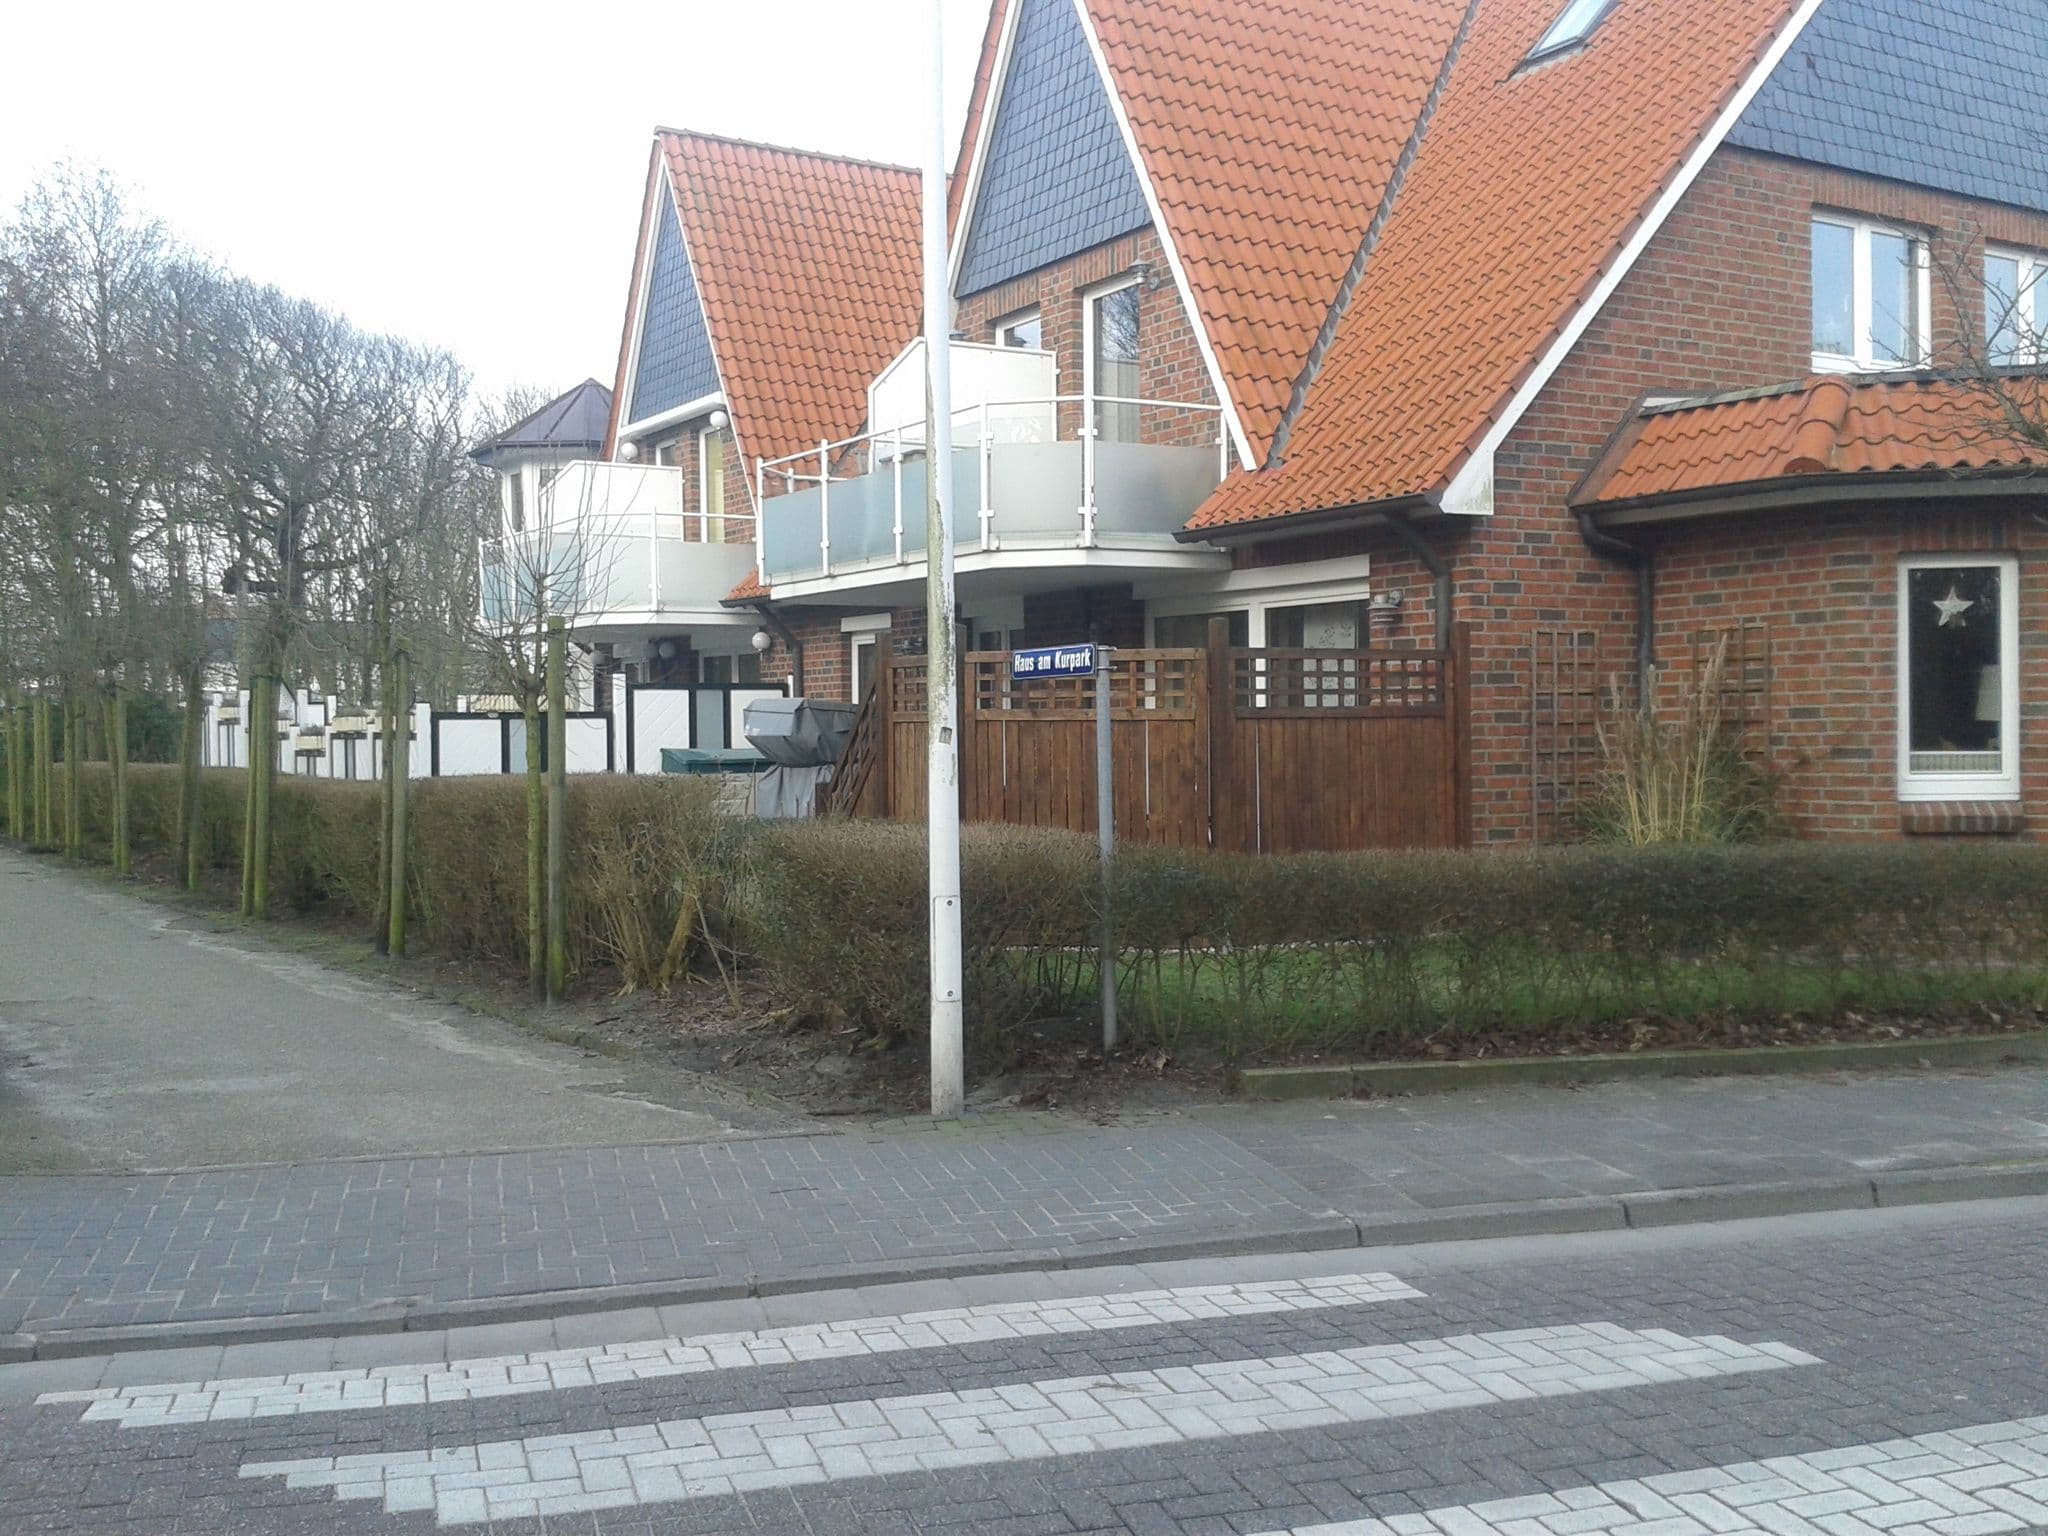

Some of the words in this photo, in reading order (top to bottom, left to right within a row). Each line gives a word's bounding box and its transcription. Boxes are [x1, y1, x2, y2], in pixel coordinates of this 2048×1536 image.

[1014, 654, 1034, 673] Haus
[1038, 655, 1051, 671] am
[1055, 648, 1091, 672] Kurpark
